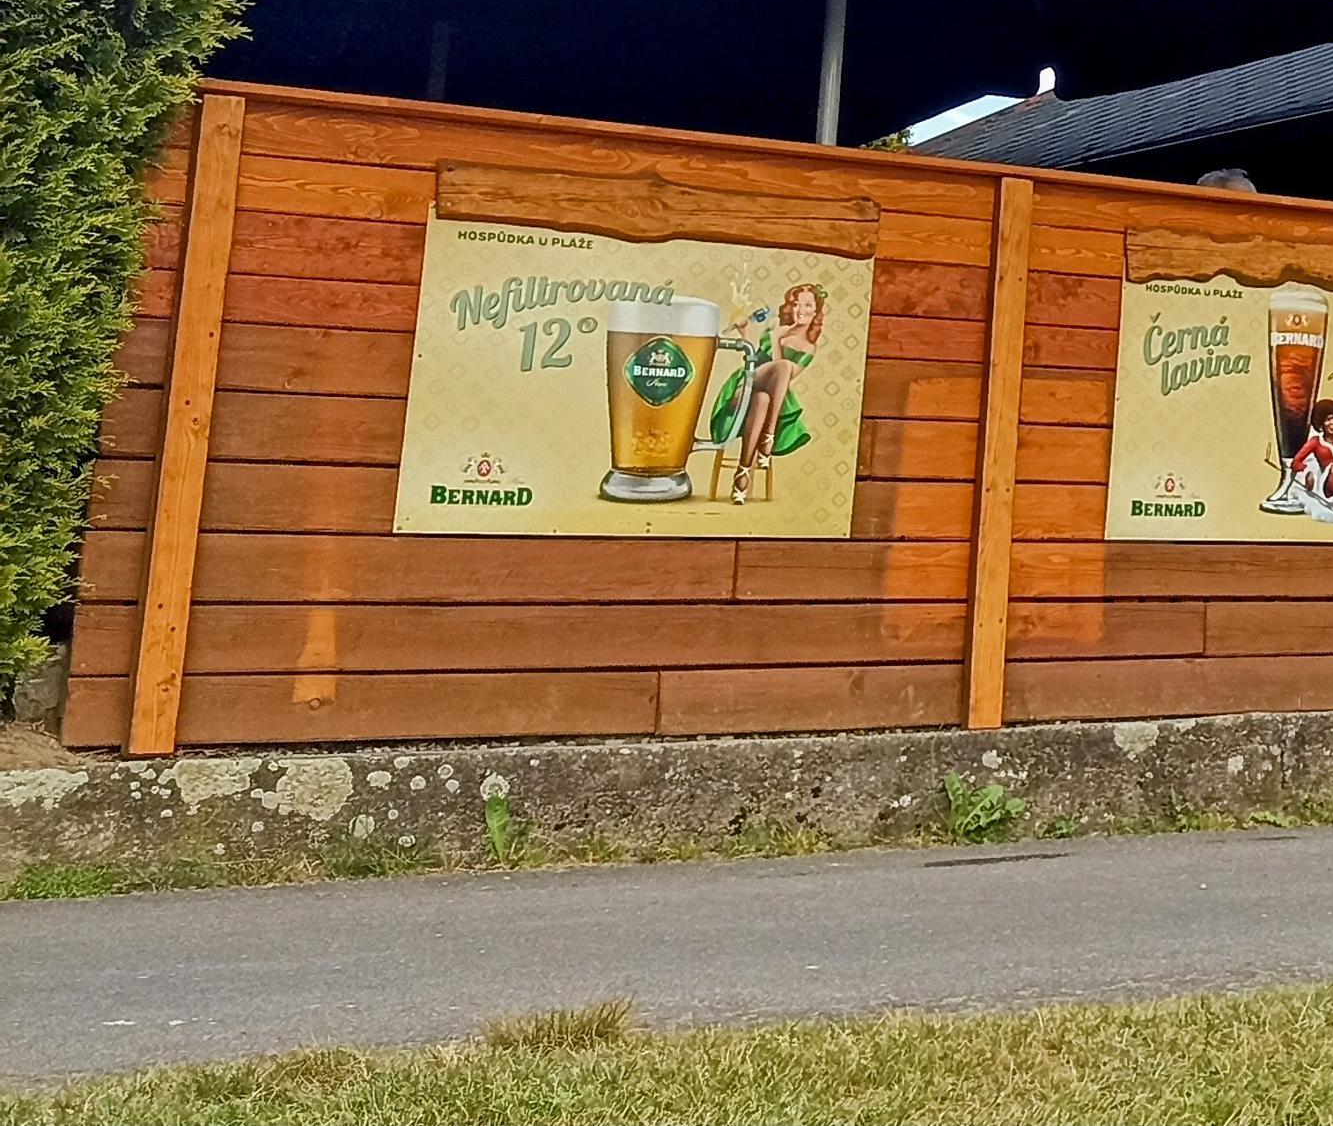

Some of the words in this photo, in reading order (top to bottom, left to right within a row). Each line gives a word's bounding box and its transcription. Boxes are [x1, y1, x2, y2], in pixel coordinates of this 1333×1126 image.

[457, 230, 534, 245] HOSPŮDKA
[539, 237, 548, 246] U
[1204, 289, 1211, 297] U
[450, 276, 676, 331] Nefiltrovaná
[1143, 312, 1231, 366] Černá
[633, 365, 686, 377] BERNARD
[1160, 348, 1251, 396] lavina
[430, 485, 533, 506] BERNARD
[1131, 500, 1206, 517] BERNARD
